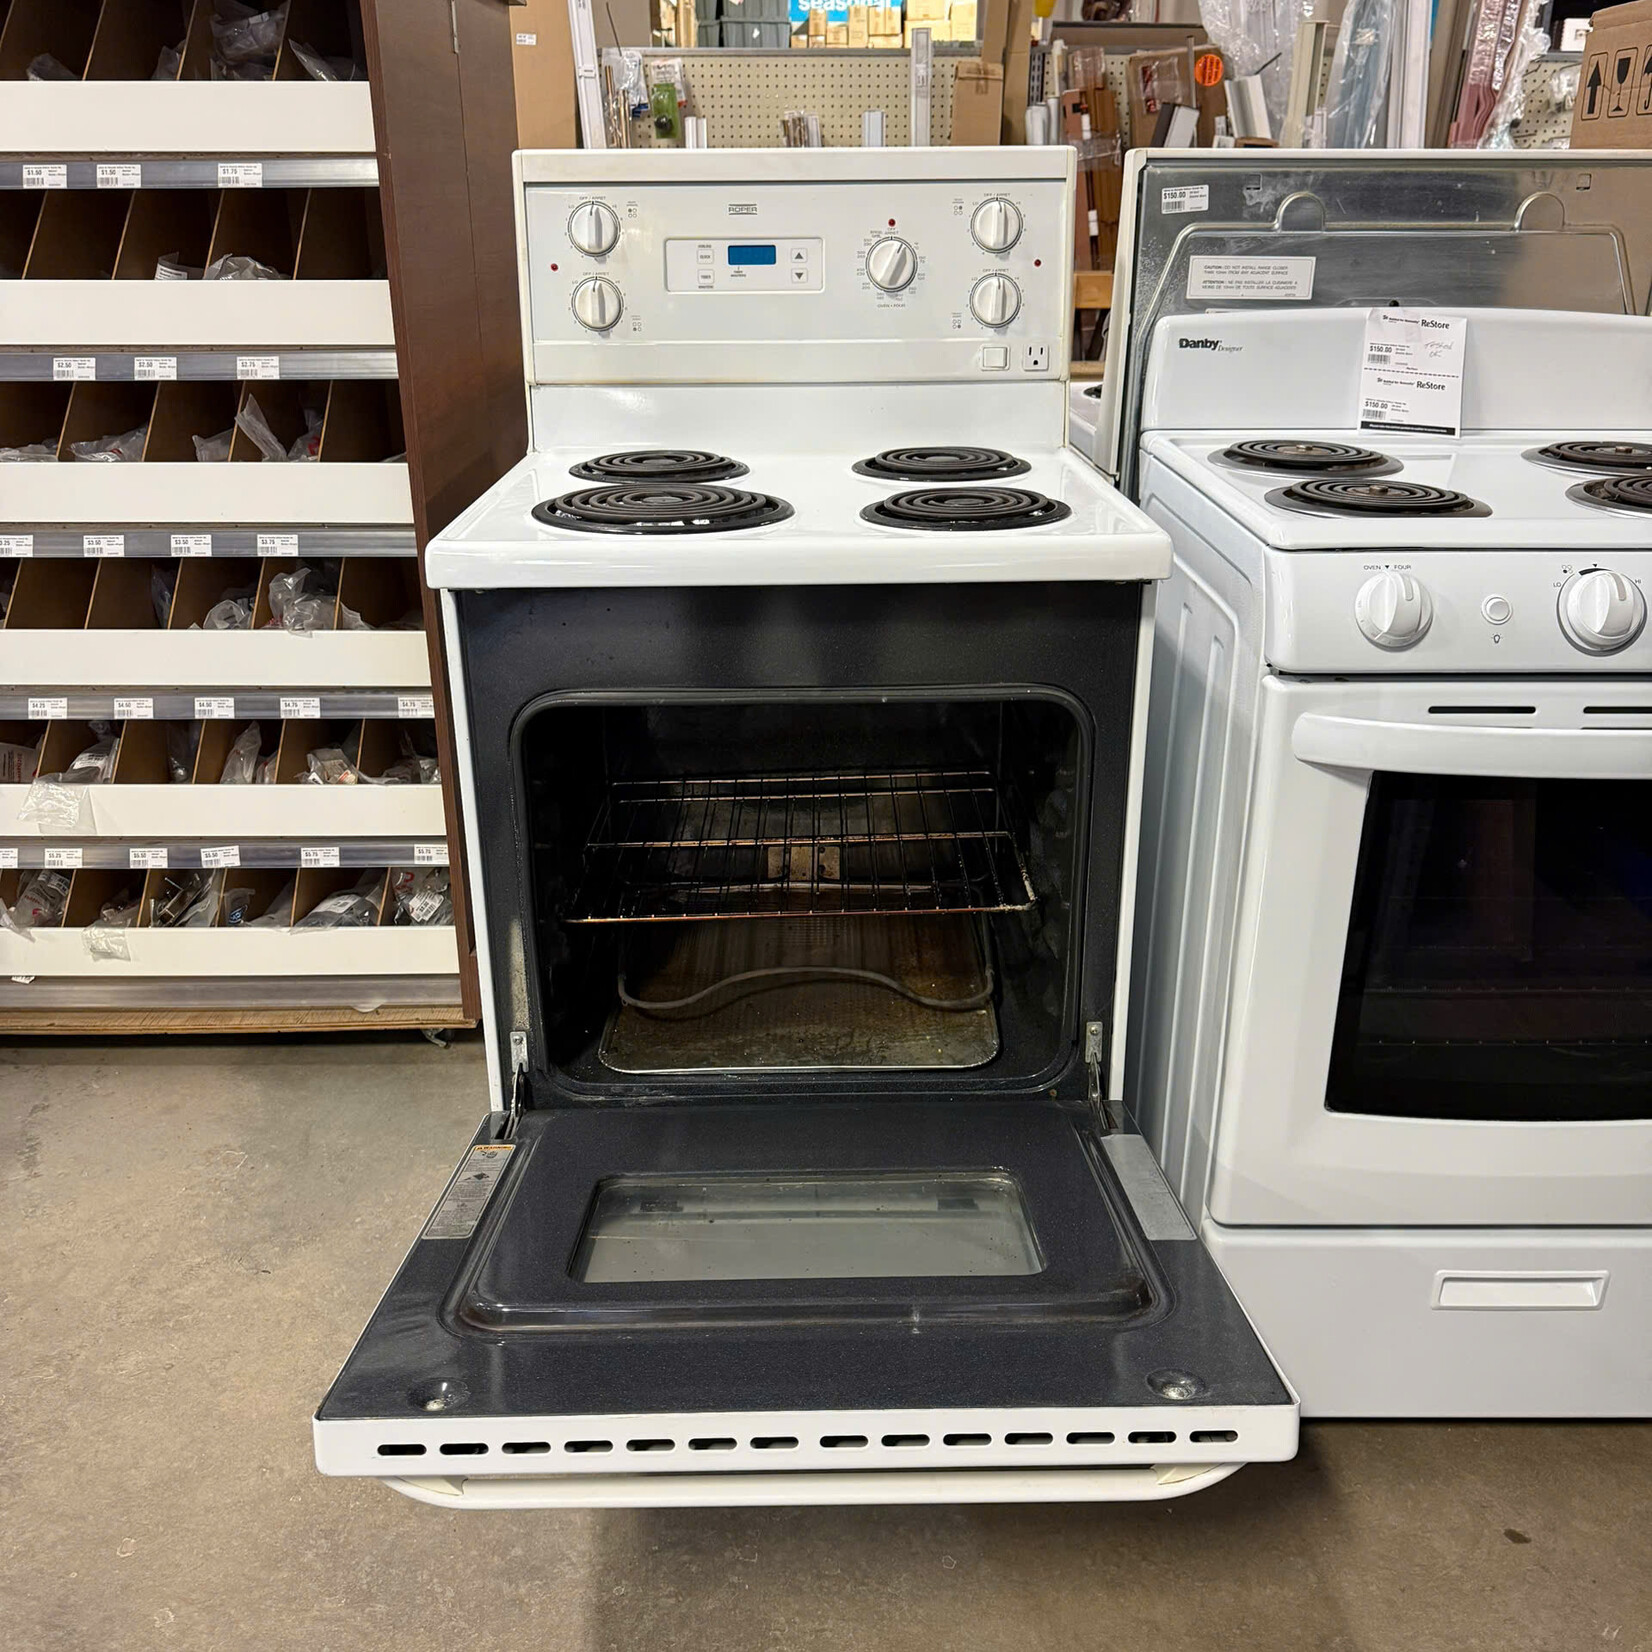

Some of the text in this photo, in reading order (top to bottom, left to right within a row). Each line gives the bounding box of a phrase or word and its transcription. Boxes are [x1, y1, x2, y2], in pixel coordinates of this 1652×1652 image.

[1163, 191, 1187, 200] $150.00
[1421, 319, 1450, 329] ReStore
[1179, 338, 1219, 350] Danby
[1369, 345, 1393, 353] $150.00
[1416, 380, 1446, 391] ReStore
[1365, 400, 1388, 409] $150.00
